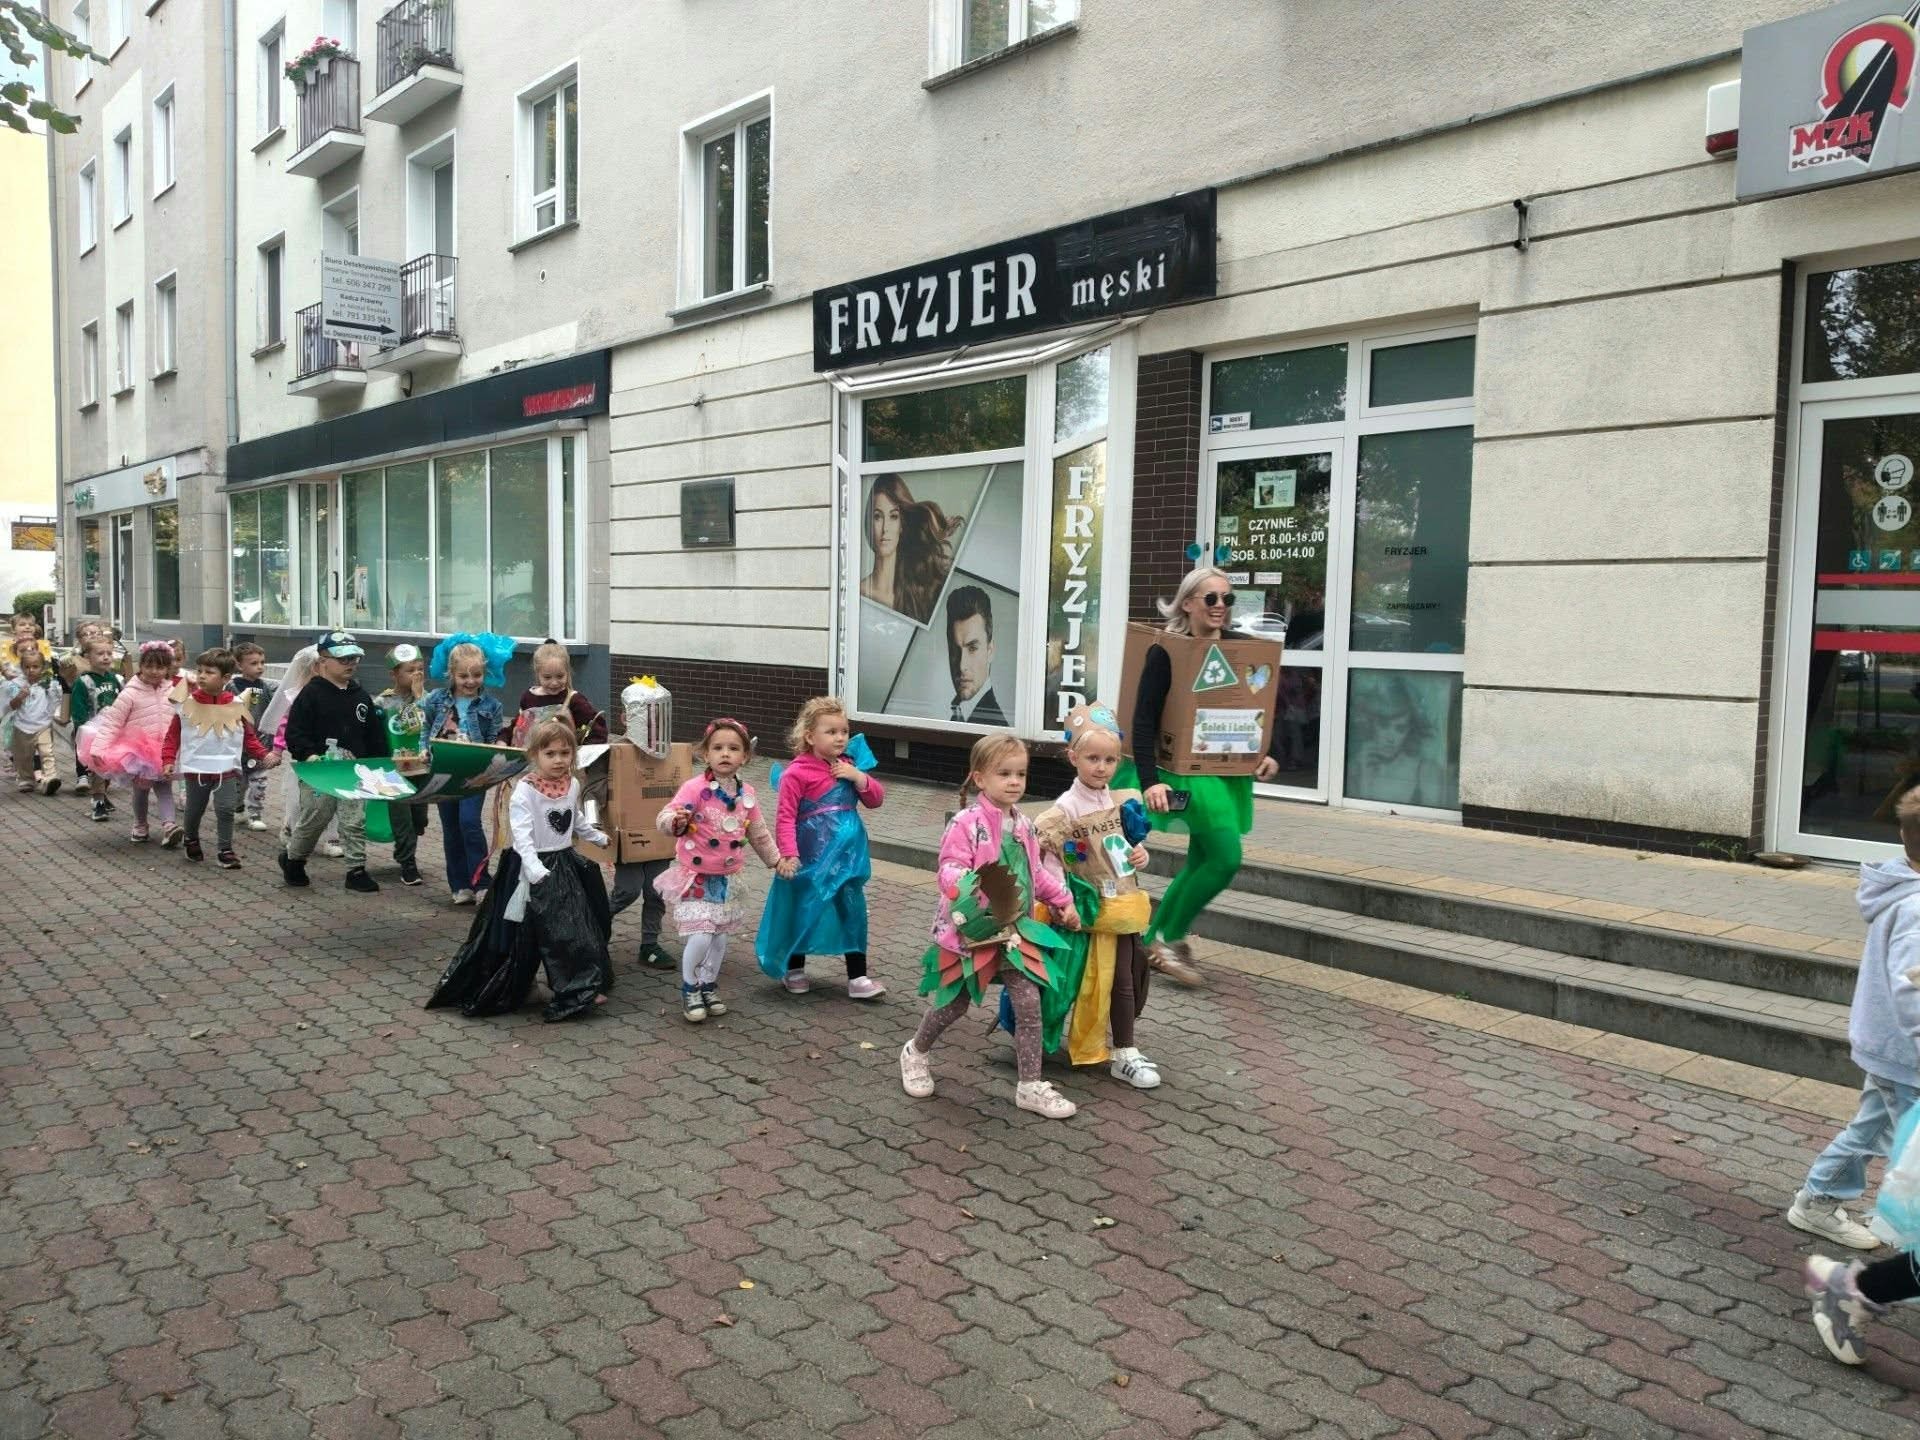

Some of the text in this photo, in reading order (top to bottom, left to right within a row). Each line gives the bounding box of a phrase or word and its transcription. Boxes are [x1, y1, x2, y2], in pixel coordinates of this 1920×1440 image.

[1793, 111, 1873, 155] MZK
[1792, 144, 1872, 169] KONIN
[829, 252, 1165, 355] FRYZJER męski
[1248, 517, 1298, 531] CZYNNE:
[1223, 536, 1241, 547] PN.
[1251, 533, 1267, 546] PT.
[1231, 546, 1315, 562] SOB. 8.00-14.00
[1384, 545, 1427, 556] FRYZJER
